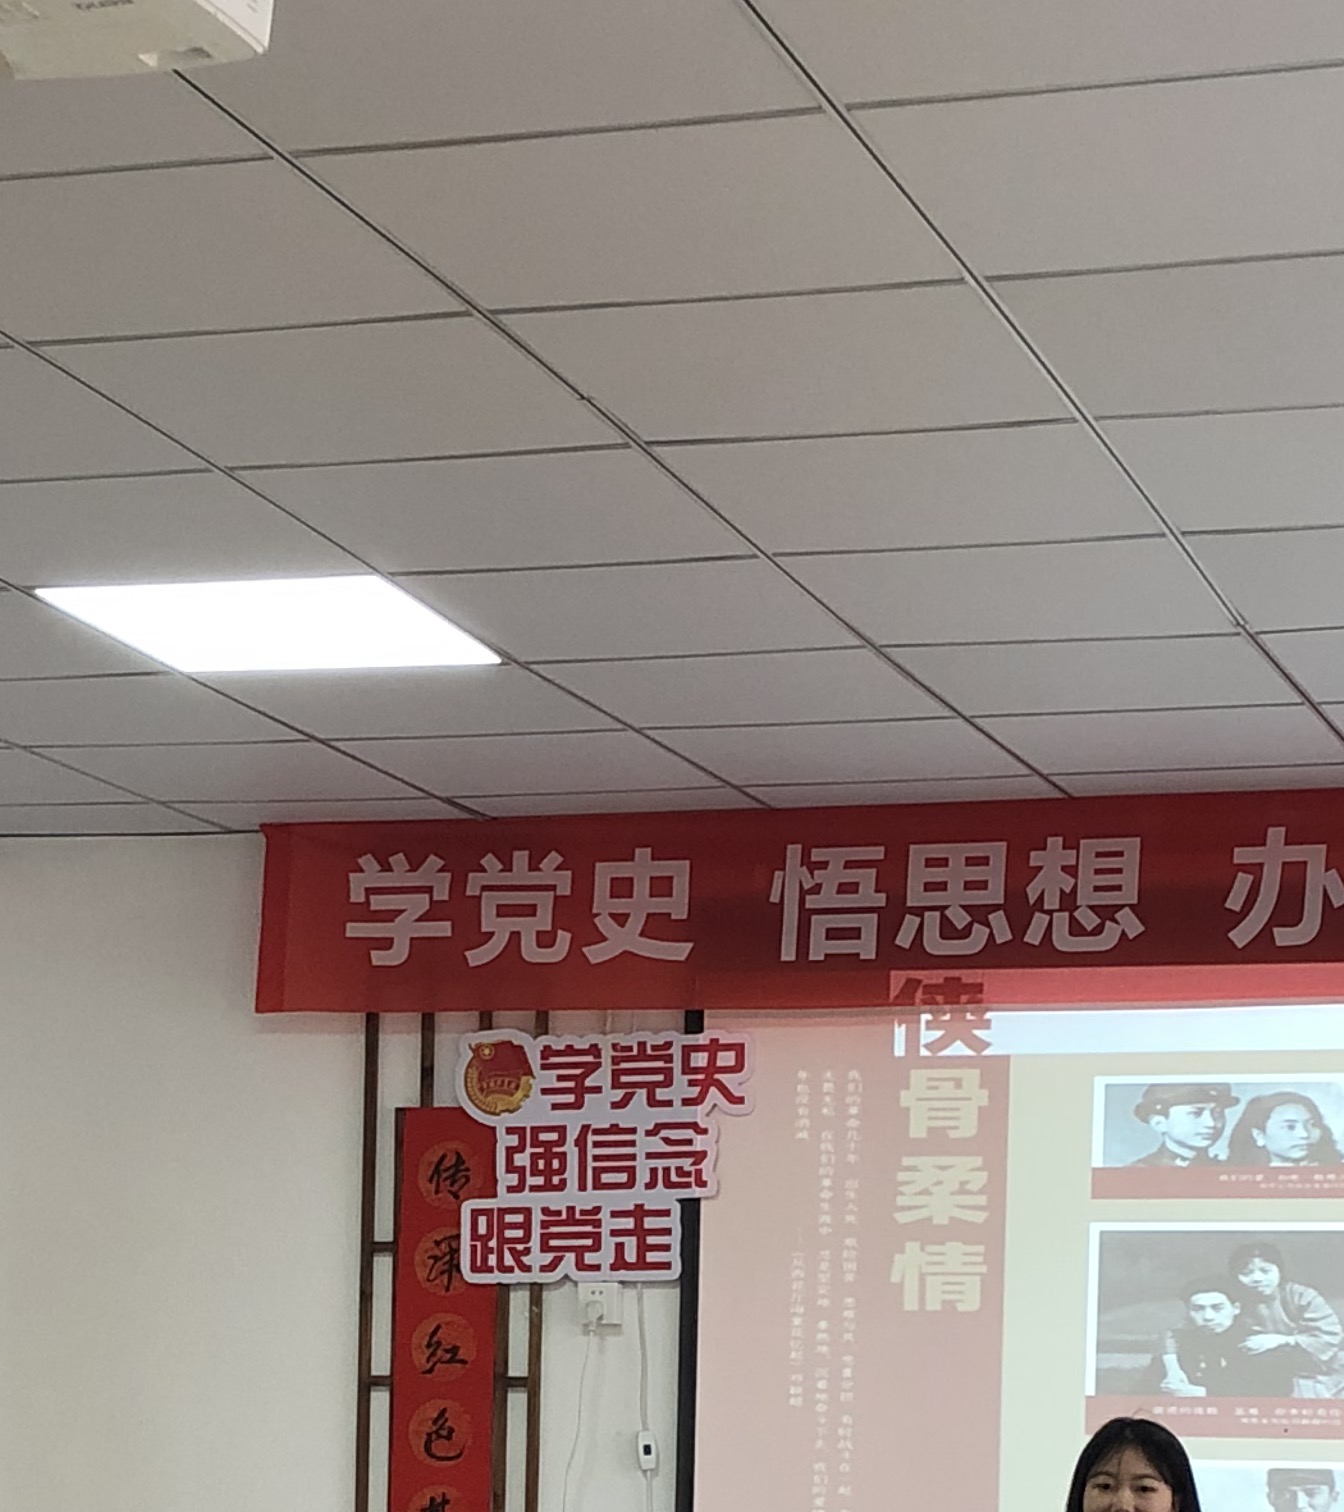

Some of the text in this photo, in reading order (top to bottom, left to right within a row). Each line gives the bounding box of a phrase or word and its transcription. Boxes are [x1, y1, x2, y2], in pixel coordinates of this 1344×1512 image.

[344, 847, 693, 968] 学党史
[769, 837, 1146, 961] 悟思想
[539, 1037, 749, 1111] 学党史
[504, 1121, 710, 1194] 强信念
[890, 976, 994, 1312] 侠骨柔情
[469, 1204, 674, 1276] 跟党走
